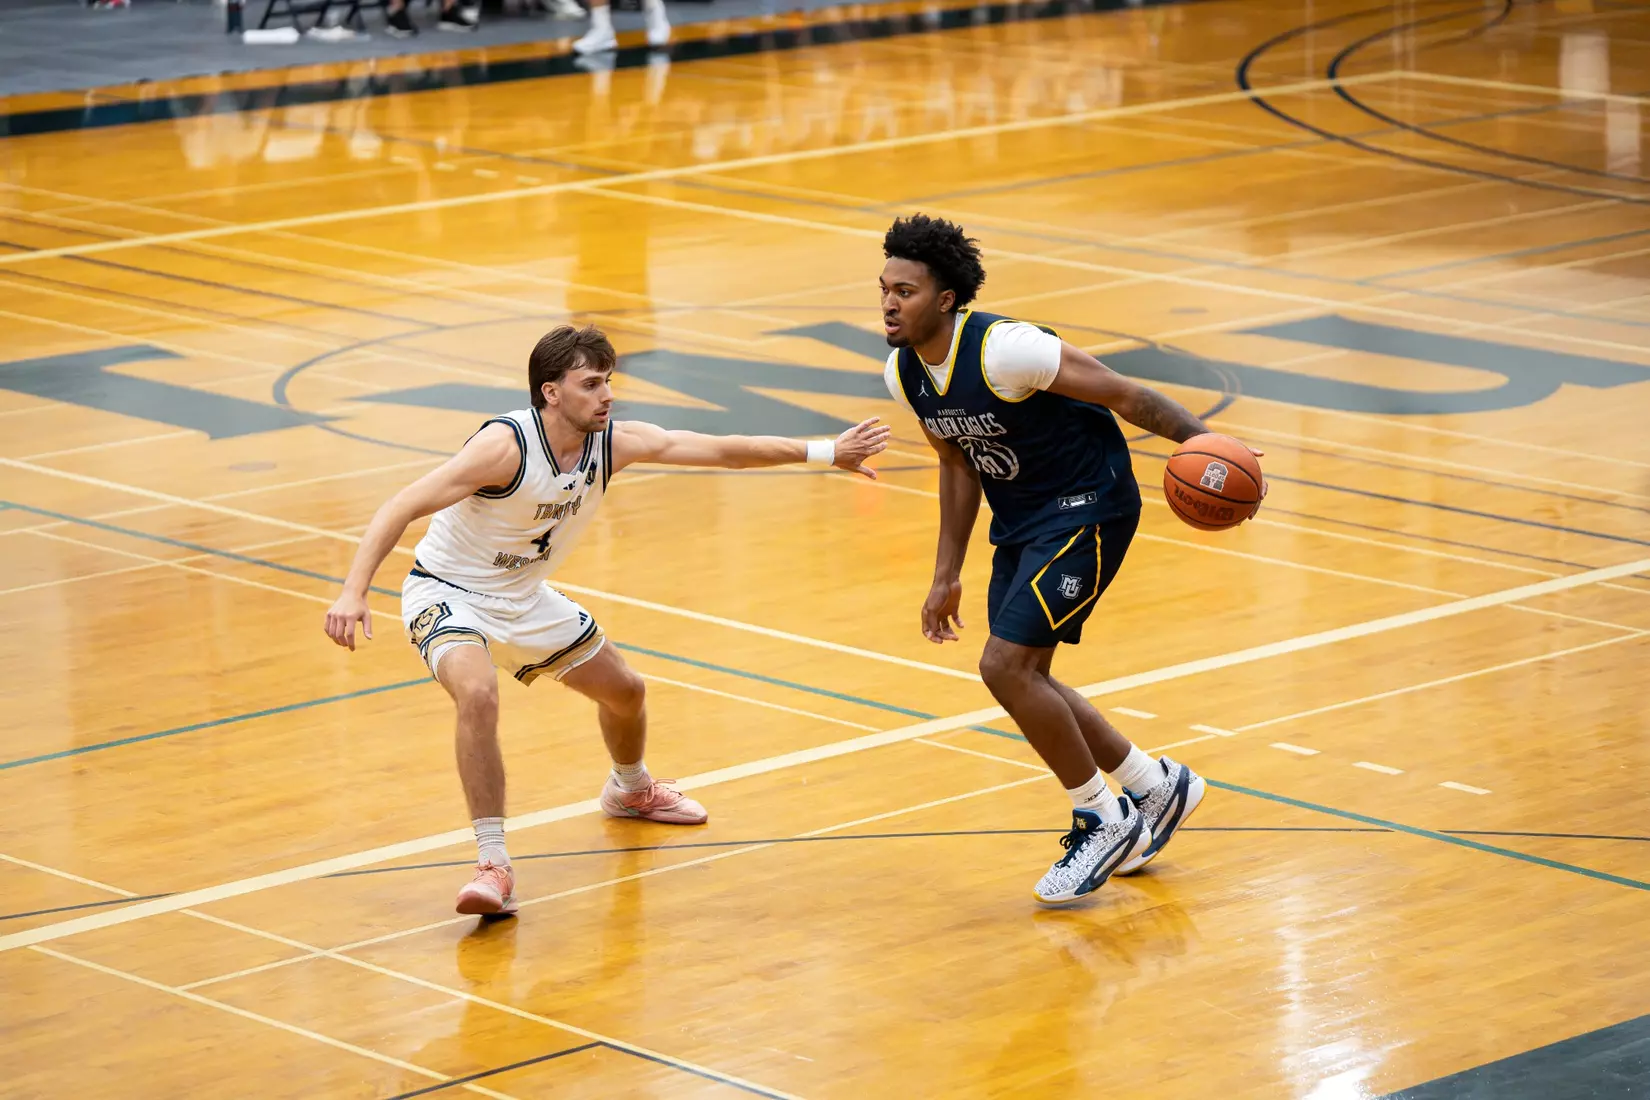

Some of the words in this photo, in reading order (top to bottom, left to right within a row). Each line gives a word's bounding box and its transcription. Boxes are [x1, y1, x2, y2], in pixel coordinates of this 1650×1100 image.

[956, 412, 1007, 437] EAGLES
[533, 495, 582, 520] TRINTY
[530, 525, 556, 553] 4
[1057, 573, 1083, 599] MU
